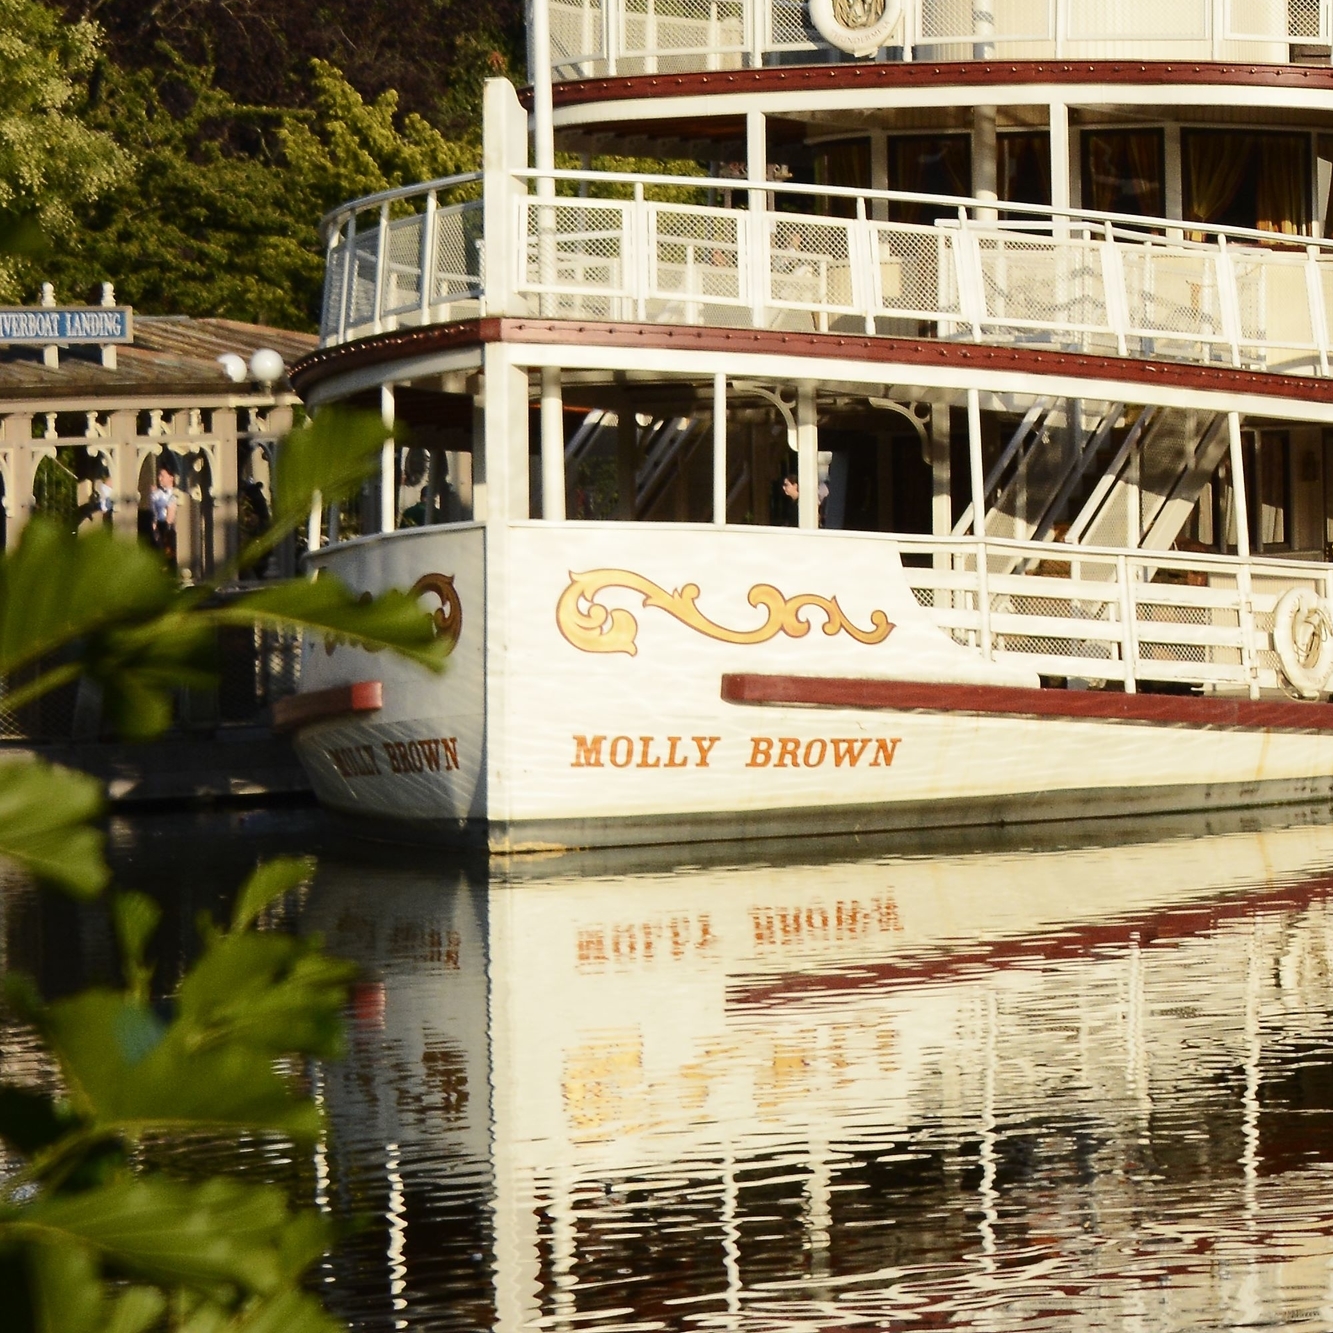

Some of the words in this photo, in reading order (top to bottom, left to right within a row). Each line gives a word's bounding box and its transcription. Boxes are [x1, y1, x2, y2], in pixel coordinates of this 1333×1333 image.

[64, 312, 122, 336] LANDING
[382, 736, 460, 773] BROWN
[571, 735, 721, 768] MOLLY
[744, 737, 902, 768] BROWN
